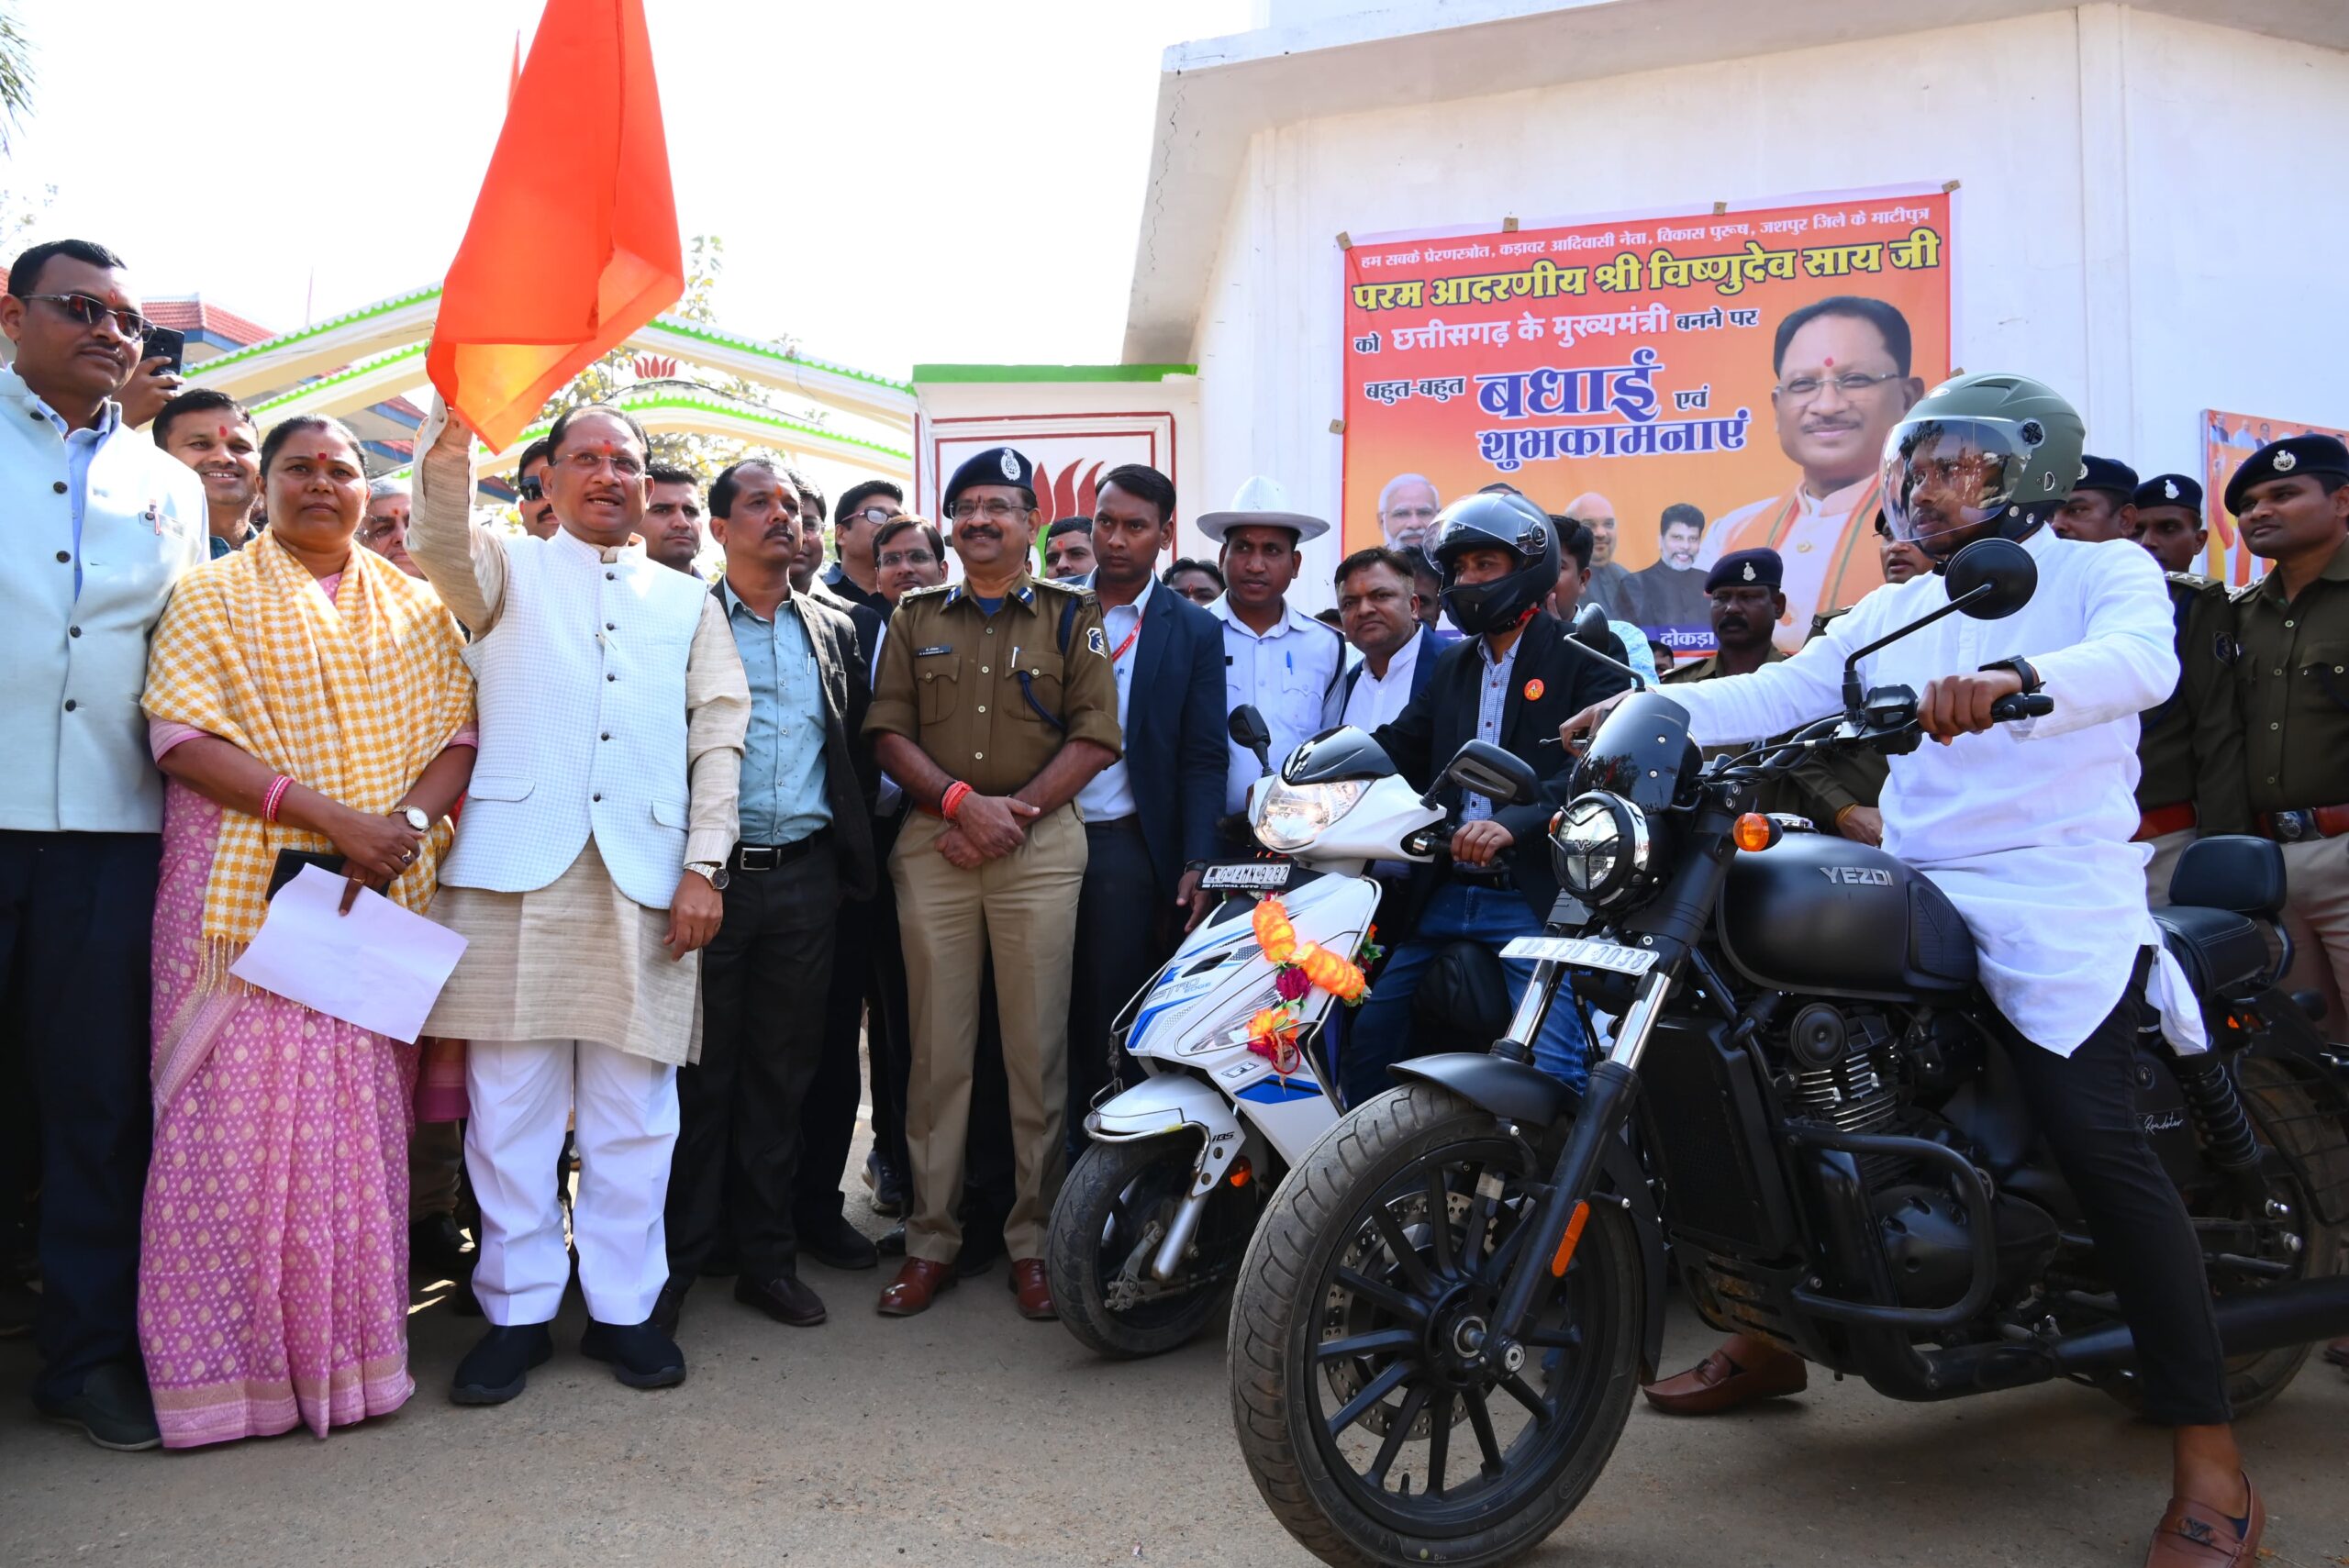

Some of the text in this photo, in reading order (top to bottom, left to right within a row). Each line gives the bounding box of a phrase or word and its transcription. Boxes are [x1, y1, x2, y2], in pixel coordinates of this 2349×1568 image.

[1352, 226, 1942, 312] परम आदरणीय श्री विष्णुदेव साय जी
[1361, 255, 1382, 269] हम
[1386, 249, 1420, 266] सबके
[1550, 232, 1615, 252] आदिवासी
[1620, 230, 1653, 247] नेता,
[1657, 227, 1705, 243] विकास
[1760, 218, 1809, 236] जशपुर
[1813, 212, 1846, 229] जिले
[1850, 209, 1866, 226] के
[1871, 206, 1931, 226] माटीपुत्र
[1353, 303, 1759, 354] को छत्तीसगढ़ के मुख्यमंत्री बनने पर
[1364, 348, 1710, 422] बहुत-बहुत बधाई एवं
[1476, 409, 1751, 472] शुभकामनाएं
[1659, 628, 1715, 648] दोकड़ा
[1820, 866, 1894, 887] YEZDI
